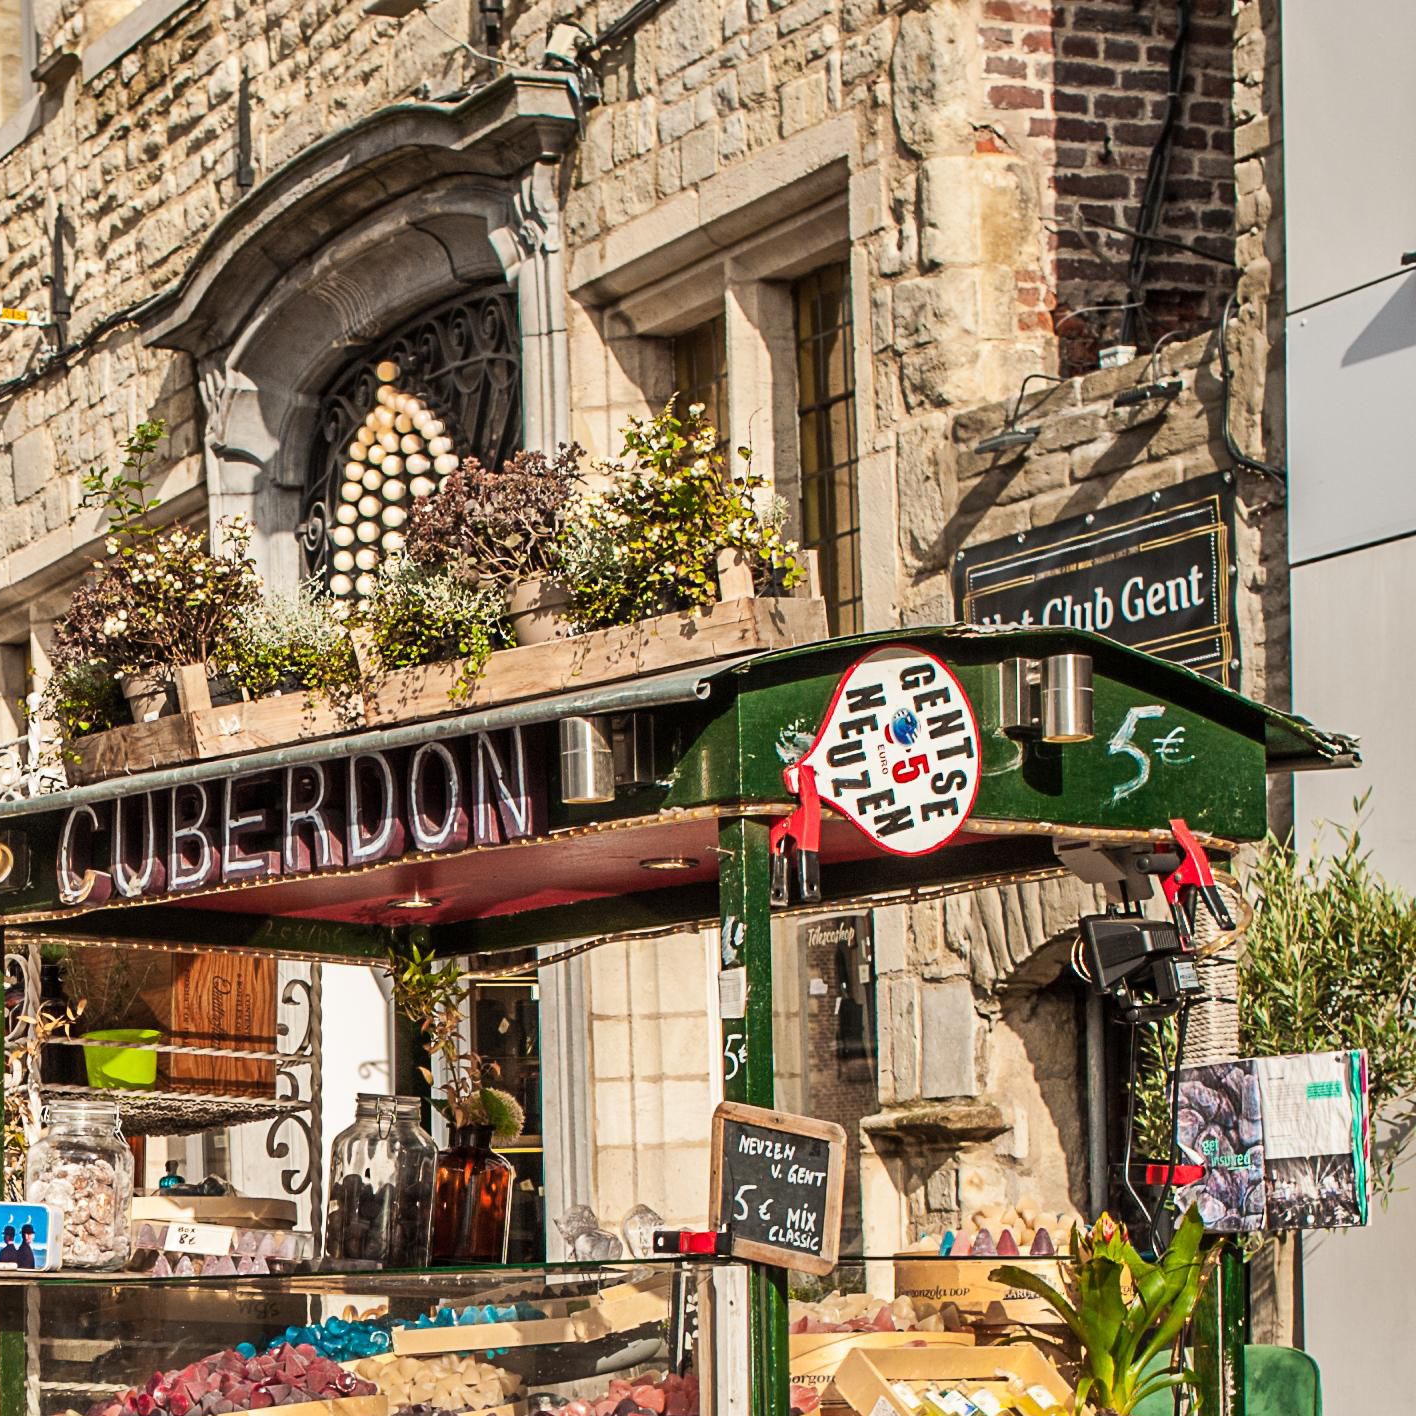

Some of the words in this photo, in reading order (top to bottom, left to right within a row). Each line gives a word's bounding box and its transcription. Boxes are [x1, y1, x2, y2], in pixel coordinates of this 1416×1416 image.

[1121, 565, 1205, 622] Gent
[826, 683, 915, 838] NEUZEN
[878, 744, 889, 775] EURO
[899, 663, 975, 822] GENTSE
[892, 754, 930, 783] 5
[56, 725, 534, 904] CUBERDON
[738, 1135, 795, 1160] NEUZEN
[787, 1164, 826, 1187] GENT
